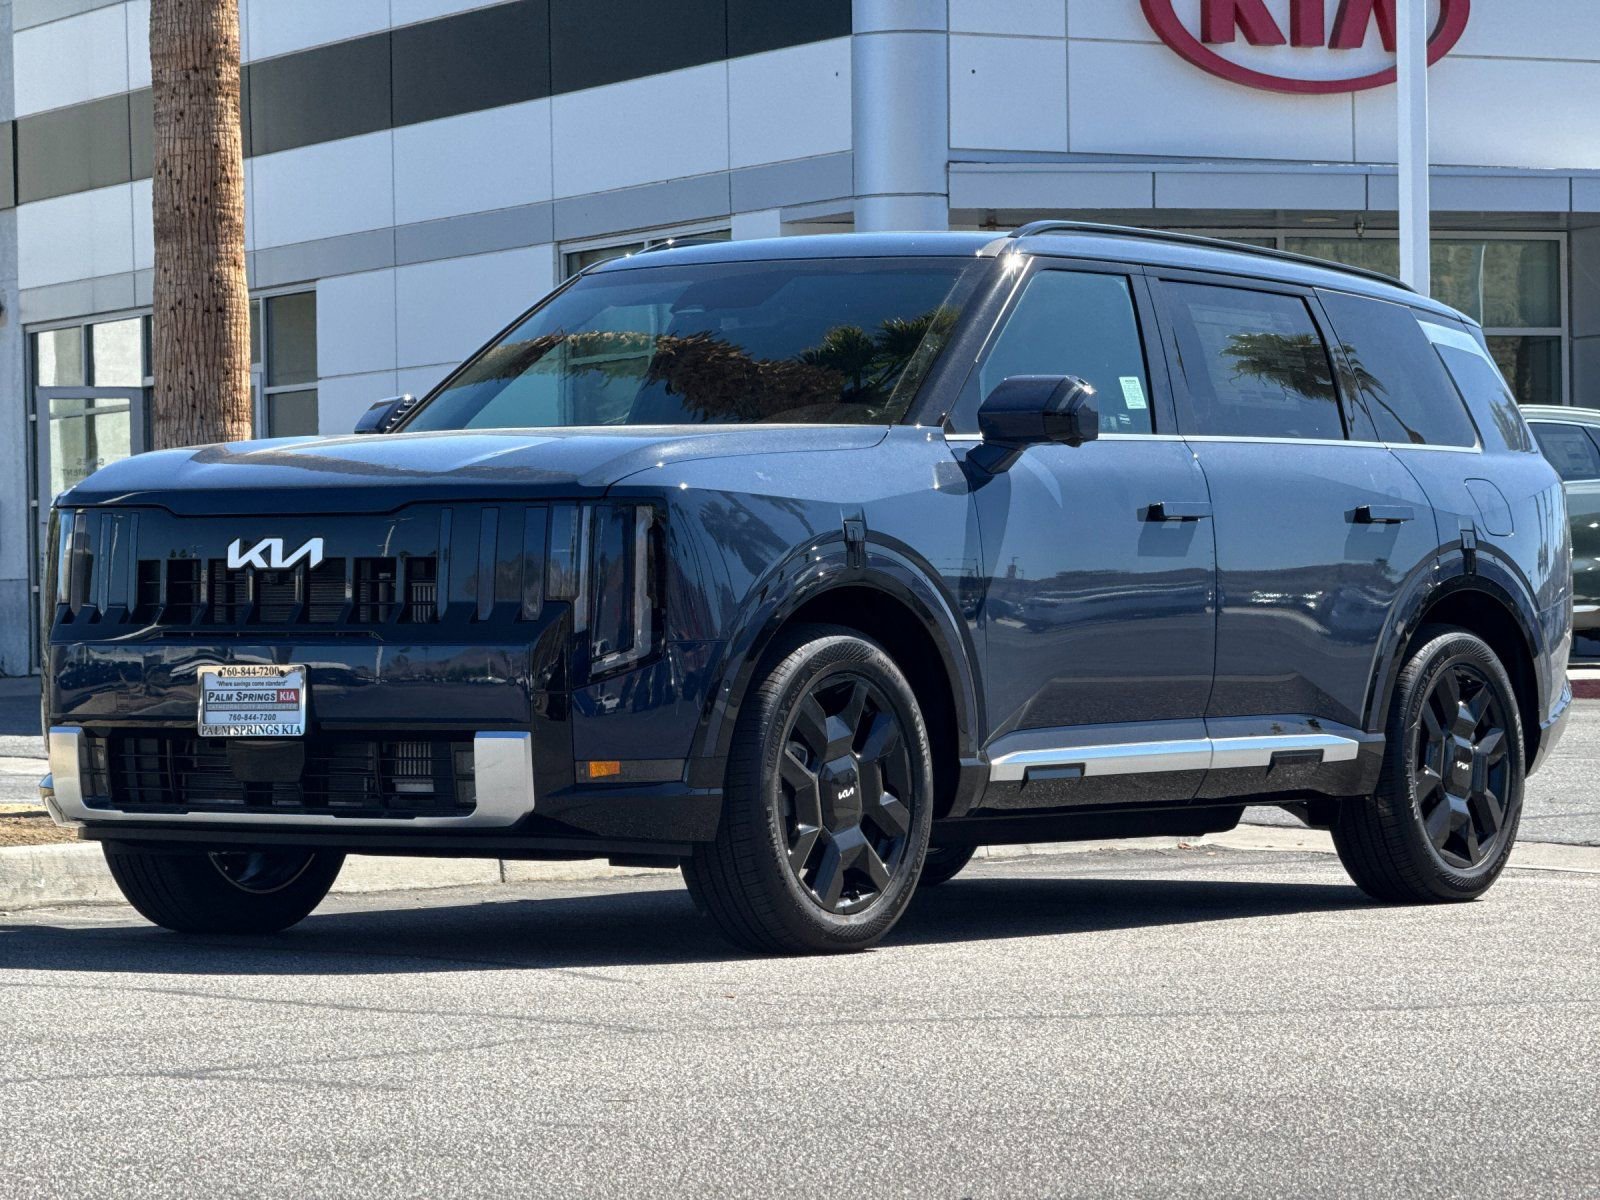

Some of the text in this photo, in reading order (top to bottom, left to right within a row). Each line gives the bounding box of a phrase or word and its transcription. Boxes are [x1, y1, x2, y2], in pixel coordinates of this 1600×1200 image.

[227, 537, 324, 569] KIA
[222, 666, 280, 677] 760-844-7200
[207, 691, 296, 702] PALM SPRINGS KIA
[228, 713, 277, 721] 760-844-7200
[201, 724, 302, 735] PALM SPRINGS KIA
